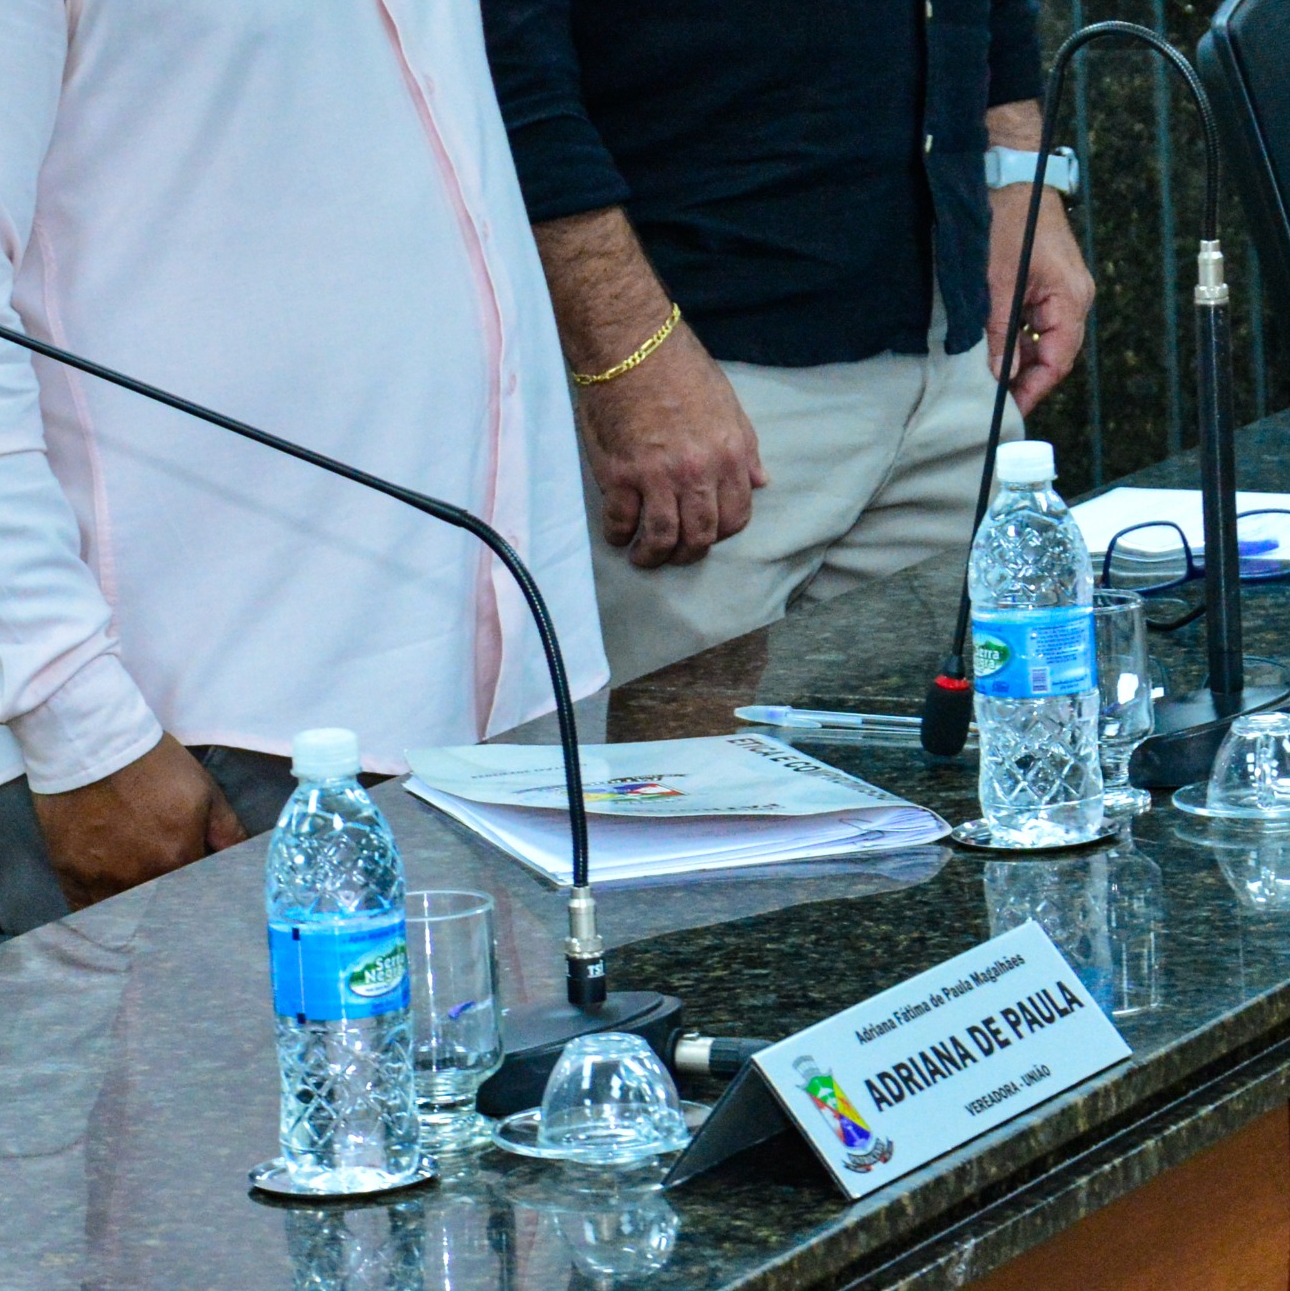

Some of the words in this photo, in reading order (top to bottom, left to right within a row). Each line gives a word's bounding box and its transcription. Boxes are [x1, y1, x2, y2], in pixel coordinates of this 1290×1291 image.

[855, 1019, 897, 1045] Adriana
[893, 1002, 932, 1025] Fátima
[930, 994, 945, 1008] de
[941, 980, 974, 1001] Paula
[969, 955, 1025, 987] Magalhães
[864, 1036, 978, 1112] ADRIANA
[966, 1016, 1011, 1057] DE
[1000, 981, 1084, 1040] PAULA
[965, 1082, 1021, 1116] VEREADORA
[1021, 1065, 1050, 1086] UNIÃO
